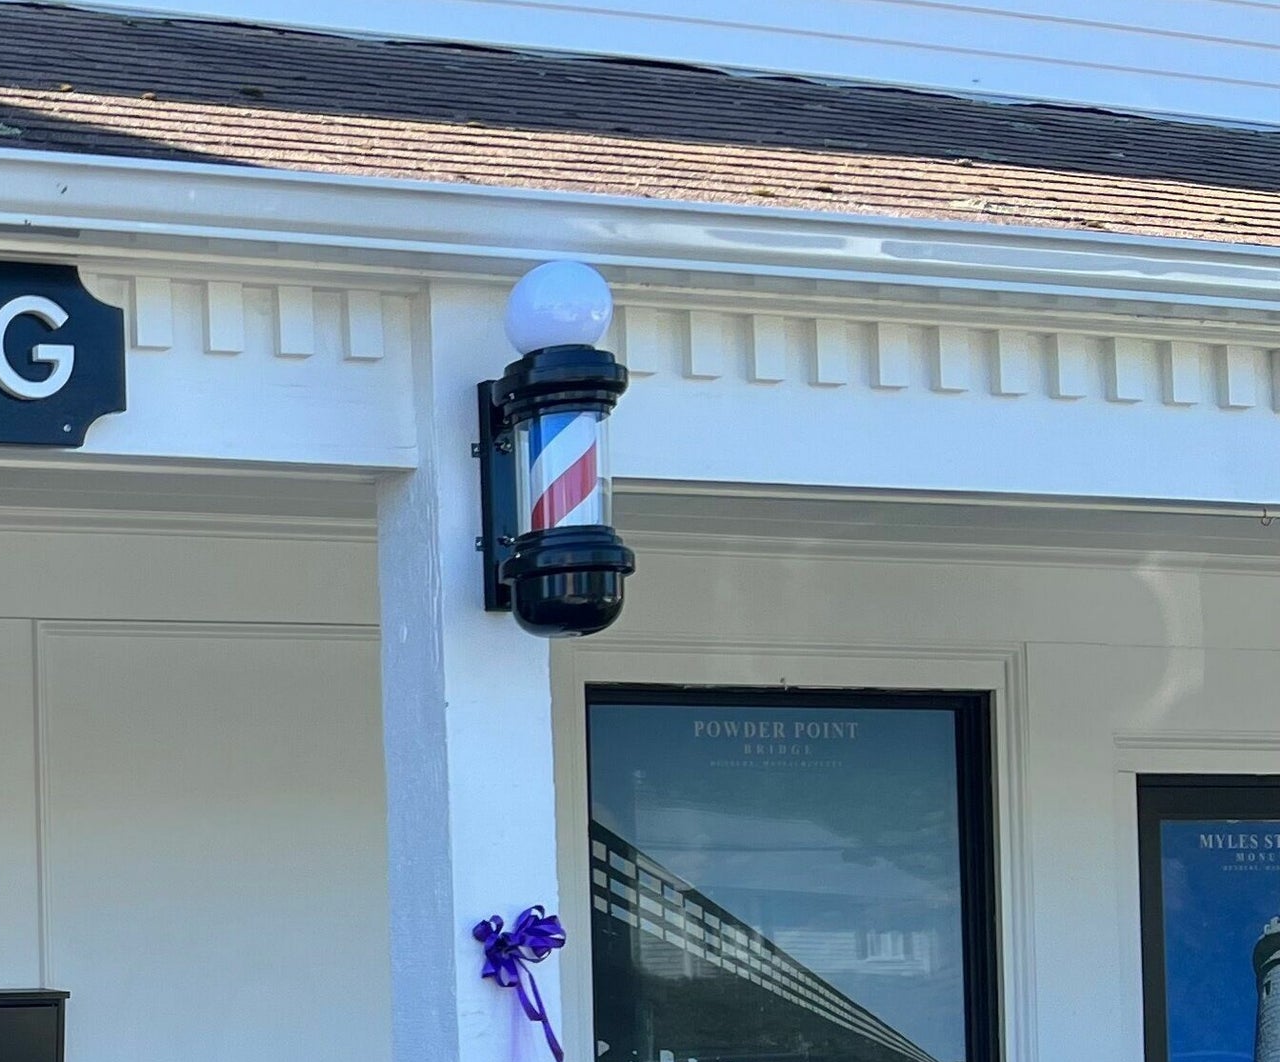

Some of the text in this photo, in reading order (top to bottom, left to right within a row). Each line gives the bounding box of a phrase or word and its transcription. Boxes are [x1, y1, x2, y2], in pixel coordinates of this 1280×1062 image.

[693, 720, 859, 739] POWDER POINT
[1200, 833, 1258, 849] MYLES
